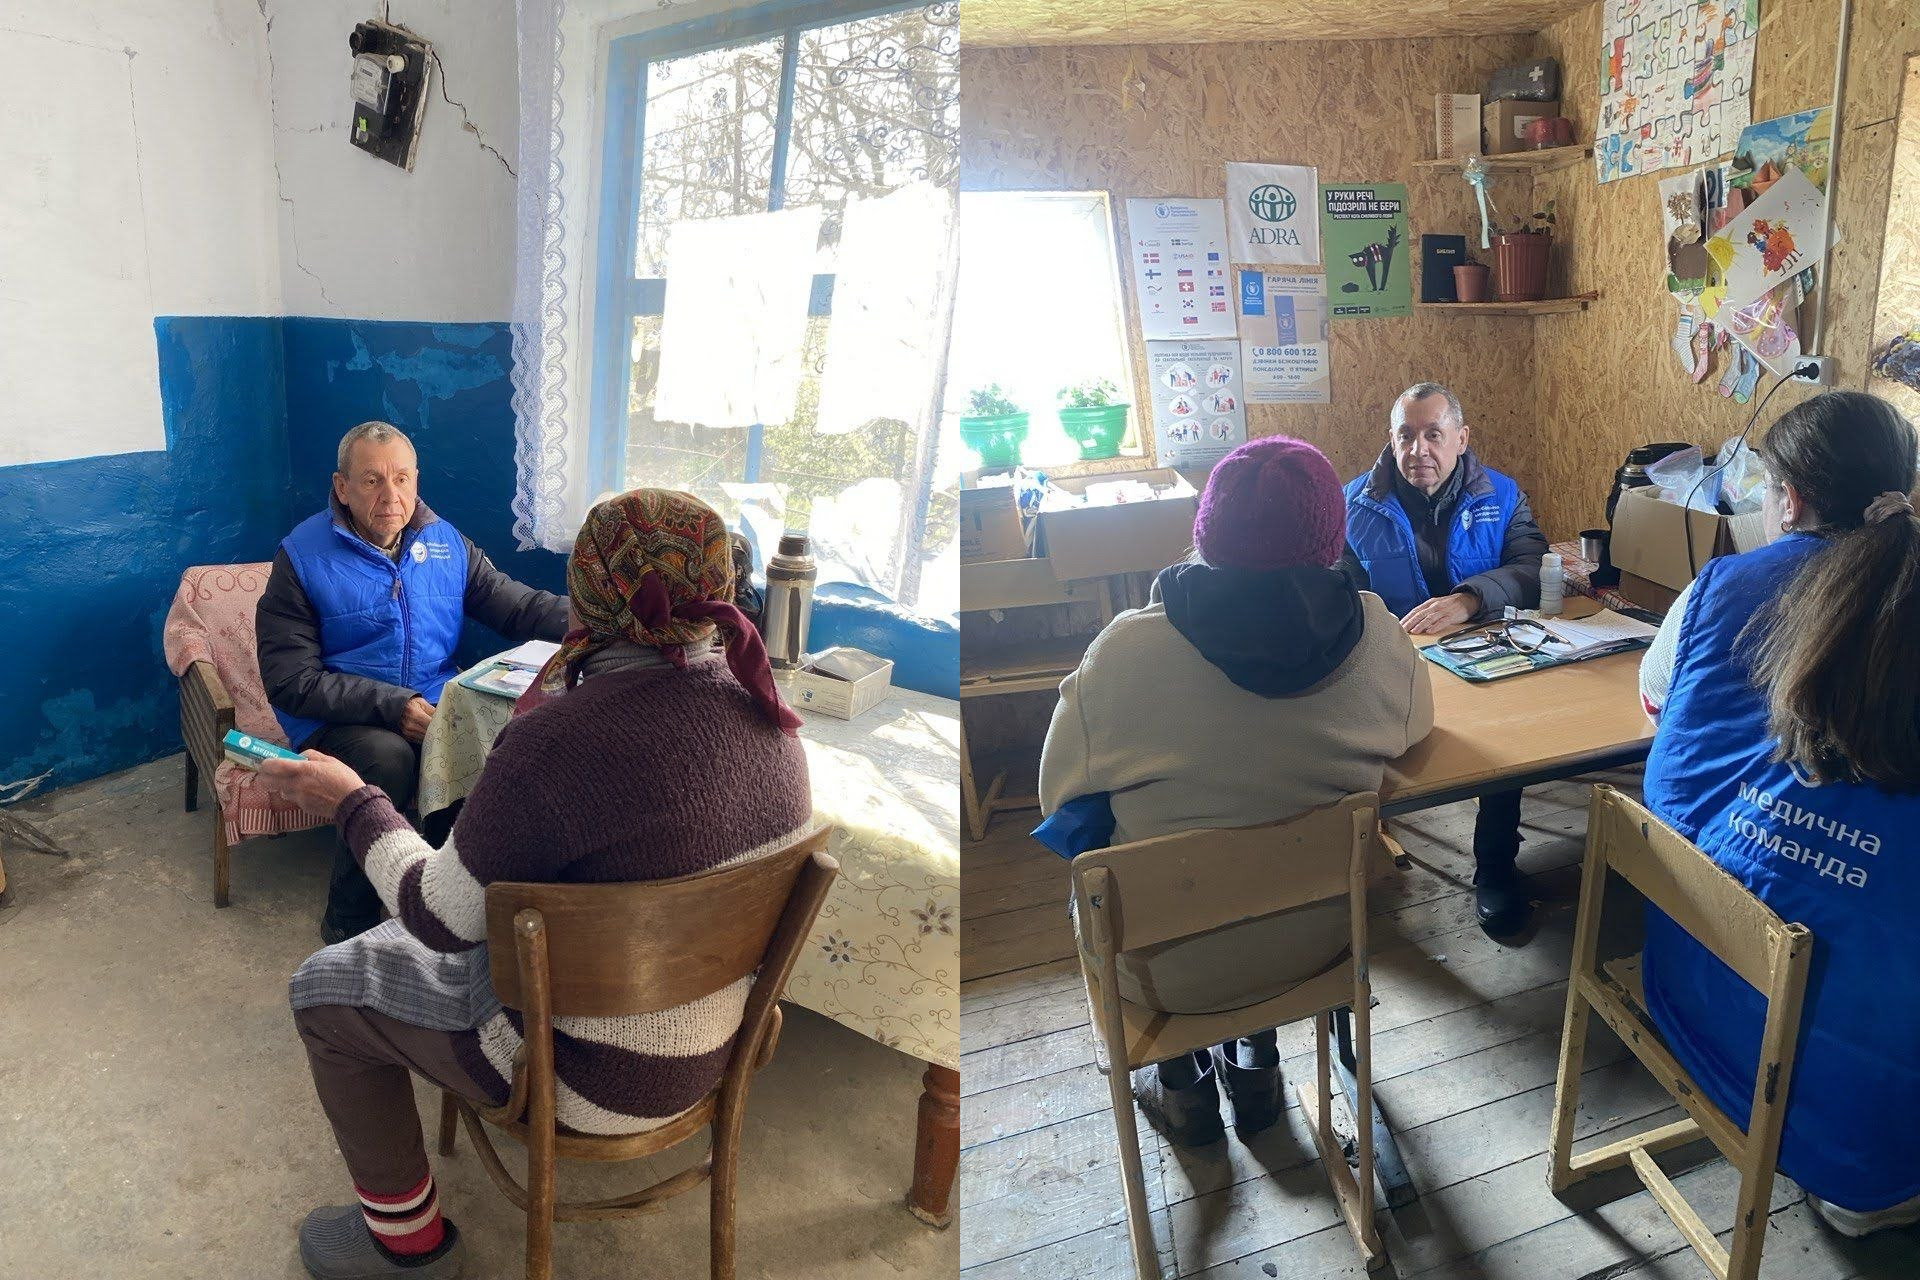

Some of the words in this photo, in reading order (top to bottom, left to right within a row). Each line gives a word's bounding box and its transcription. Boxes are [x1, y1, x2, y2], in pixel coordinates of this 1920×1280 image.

[1327, 191, 1333, 200] У
[1335, 191, 1355, 200] РУКИ
[1356, 191, 1373, 200] РЕЧІ
[1328, 202, 1367, 212] ПІДОЗРІЛІ
[1368, 202, 1378, 211] НЕ
[1380, 202, 1399, 211] БЕРИ
[1248, 227, 1301, 246] ADRA
[1258, 348, 1264, 356] 0
[1266, 348, 1282, 356] 800
[1284, 348, 1300, 356] 600
[1303, 348, 1317, 356] 122
[1737, 781, 1881, 856] медична
[1728, 811, 1868, 888] команда
